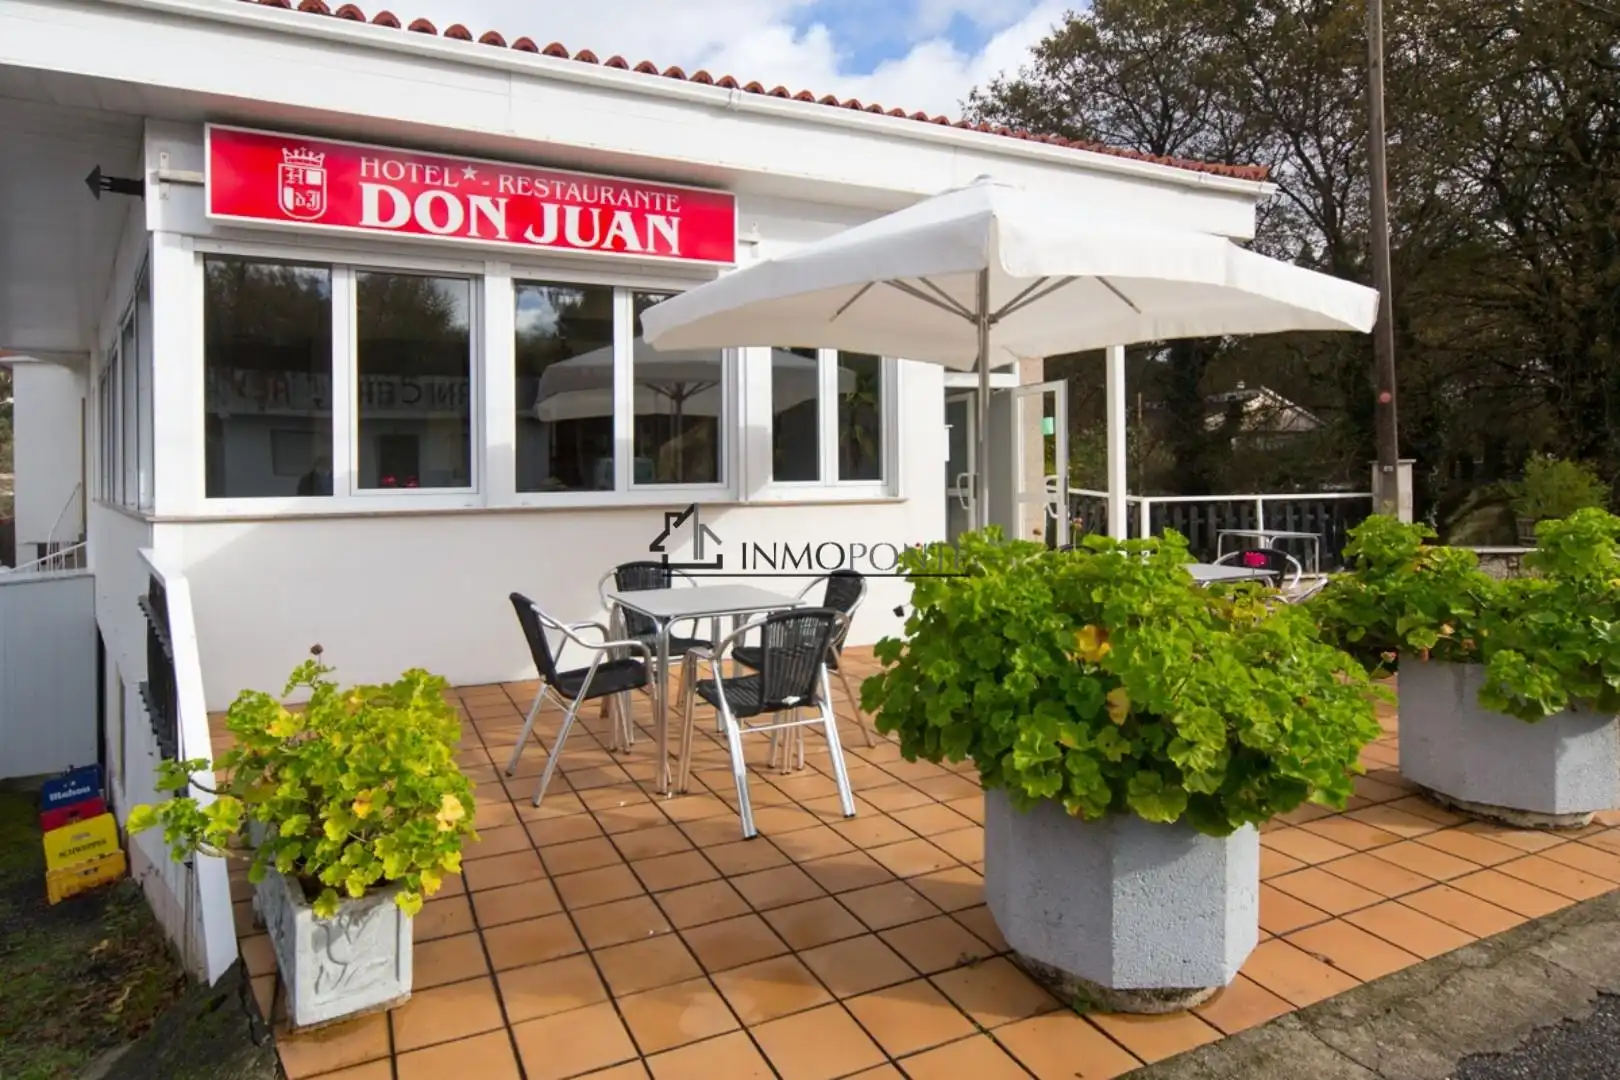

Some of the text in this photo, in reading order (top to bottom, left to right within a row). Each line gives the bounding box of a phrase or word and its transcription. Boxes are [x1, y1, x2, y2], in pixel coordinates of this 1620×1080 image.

[359, 157, 459, 188] HOTEL
[498, 174, 681, 213] RESTAURANTE
[359, 181, 681, 256] DON JUAN
